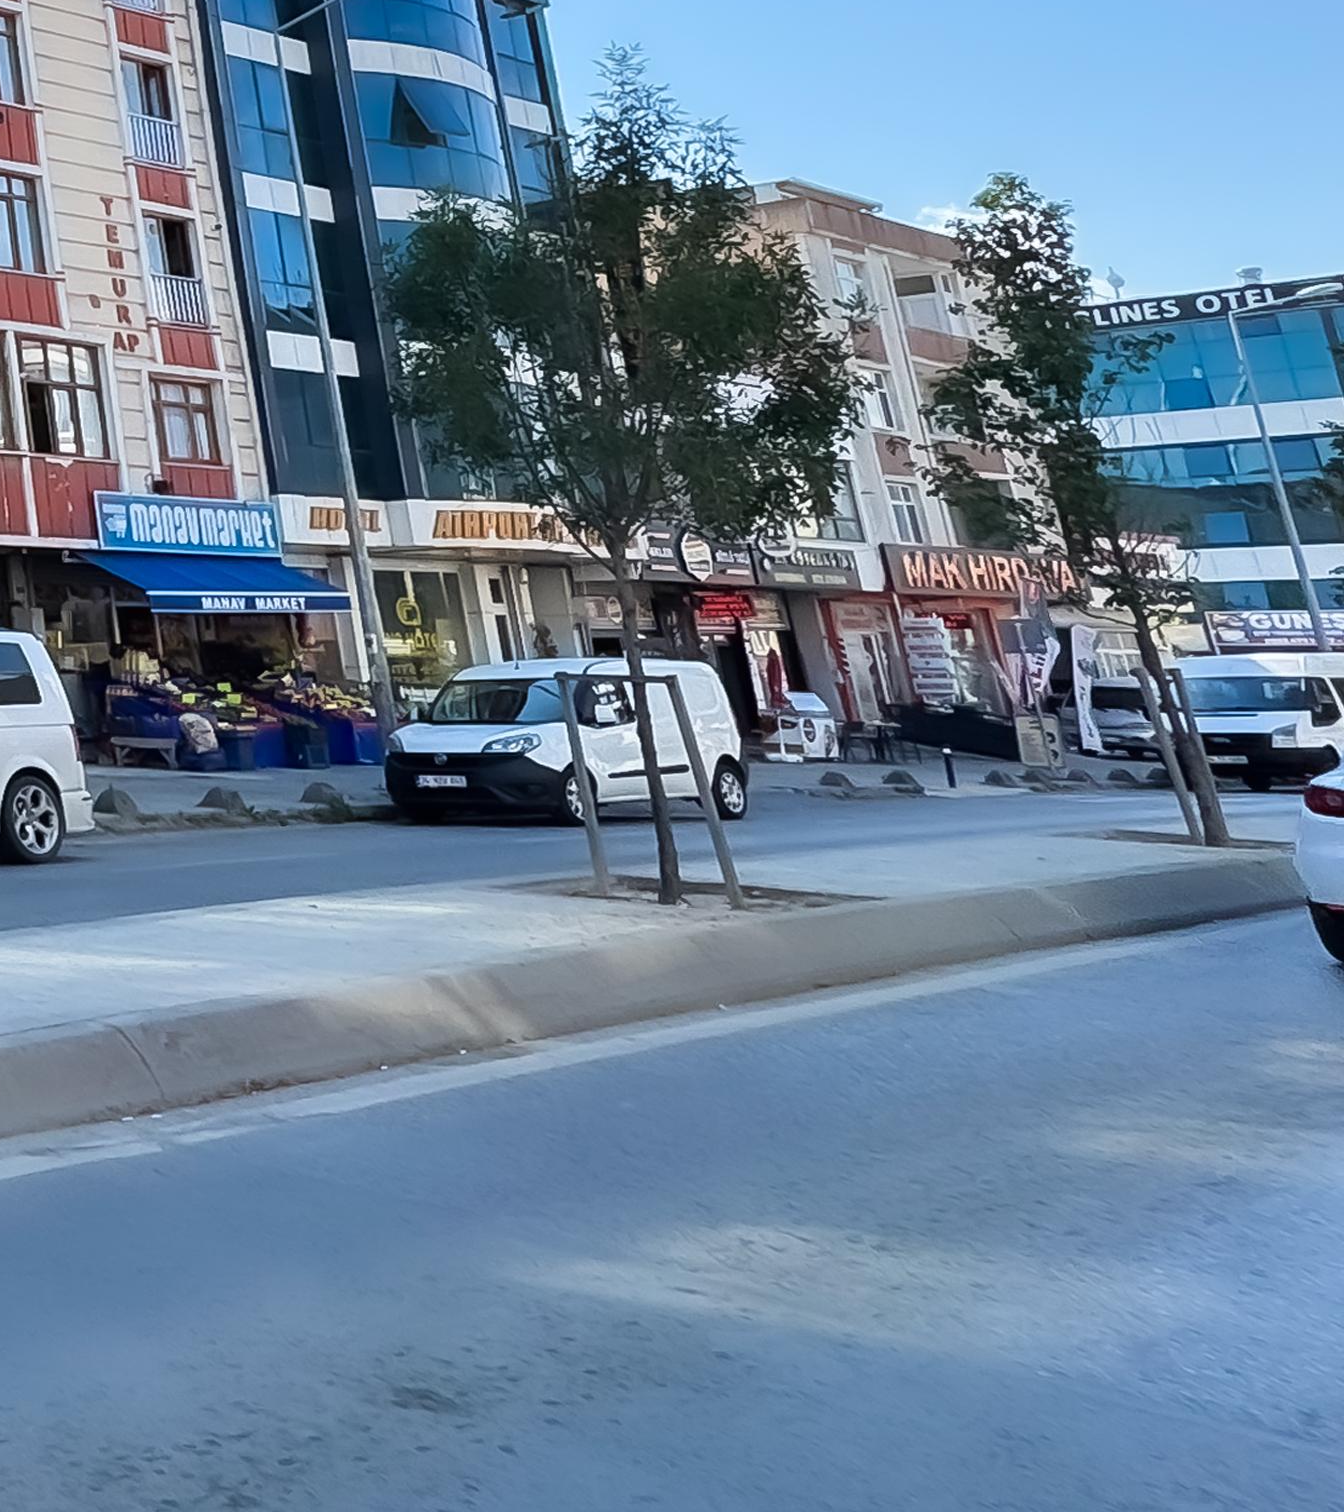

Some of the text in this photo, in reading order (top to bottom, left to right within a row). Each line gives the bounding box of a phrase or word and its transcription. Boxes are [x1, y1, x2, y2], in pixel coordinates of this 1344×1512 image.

[902, 550, 967, 590] MAK
[202, 597, 306, 611] MANAV MARKET
